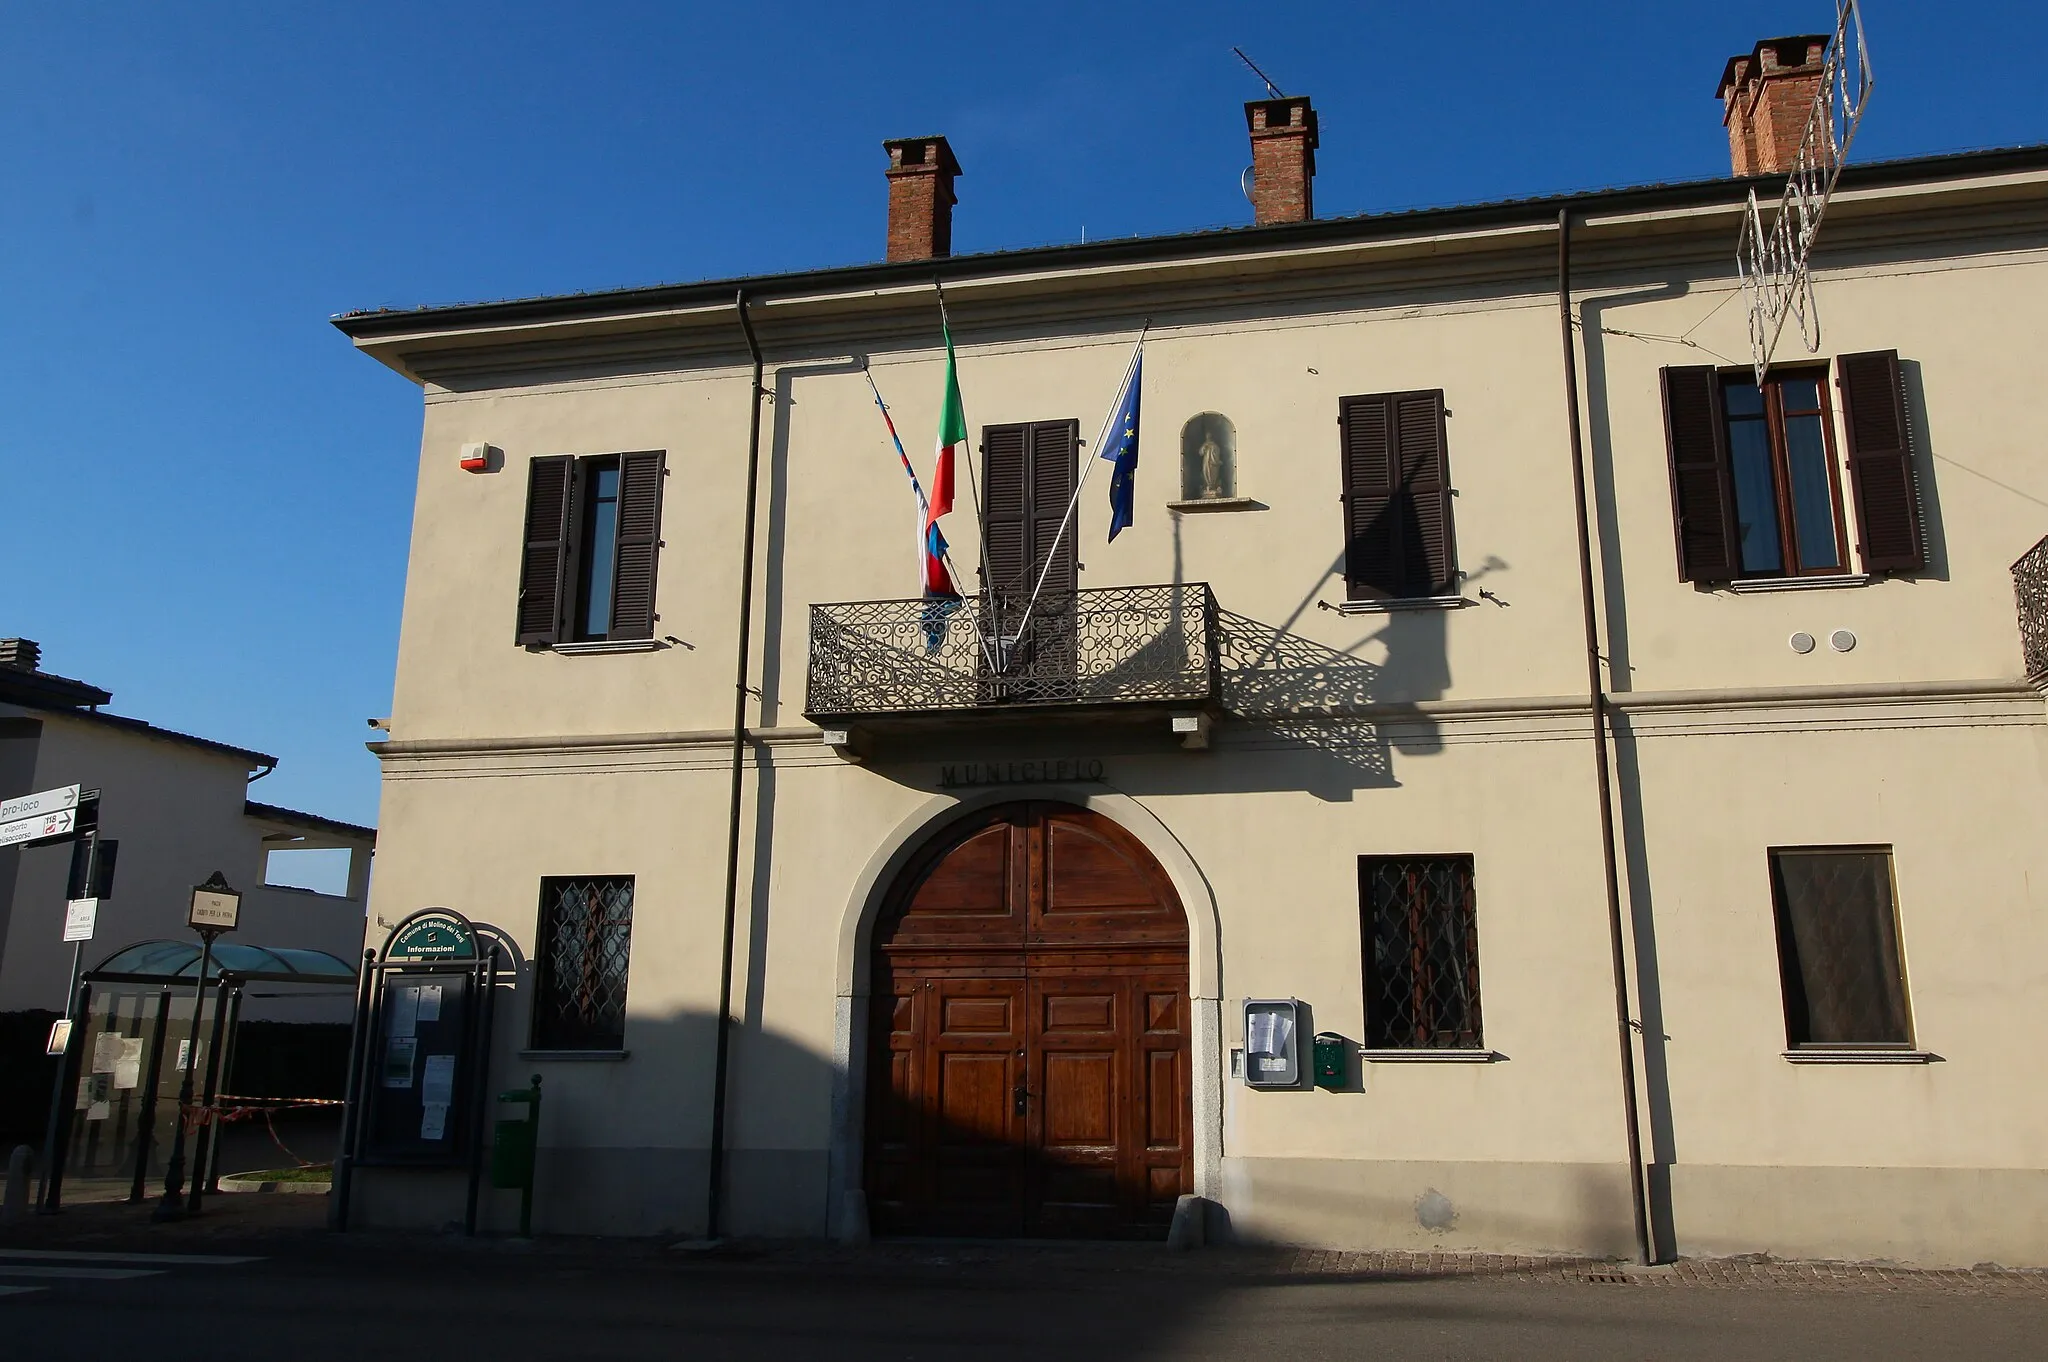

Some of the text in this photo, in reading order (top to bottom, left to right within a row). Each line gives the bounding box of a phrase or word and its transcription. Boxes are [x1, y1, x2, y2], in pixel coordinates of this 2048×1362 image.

[941, 759, 1104, 786] MUNICIPIO
[2, 800, 40, 818] pro-loco
[400, 926, 421, 943] Comune
[428, 921, 447, 929] Molino
[446, 925, 455, 934] dei
[407, 945, 455, 953] Informazioni
